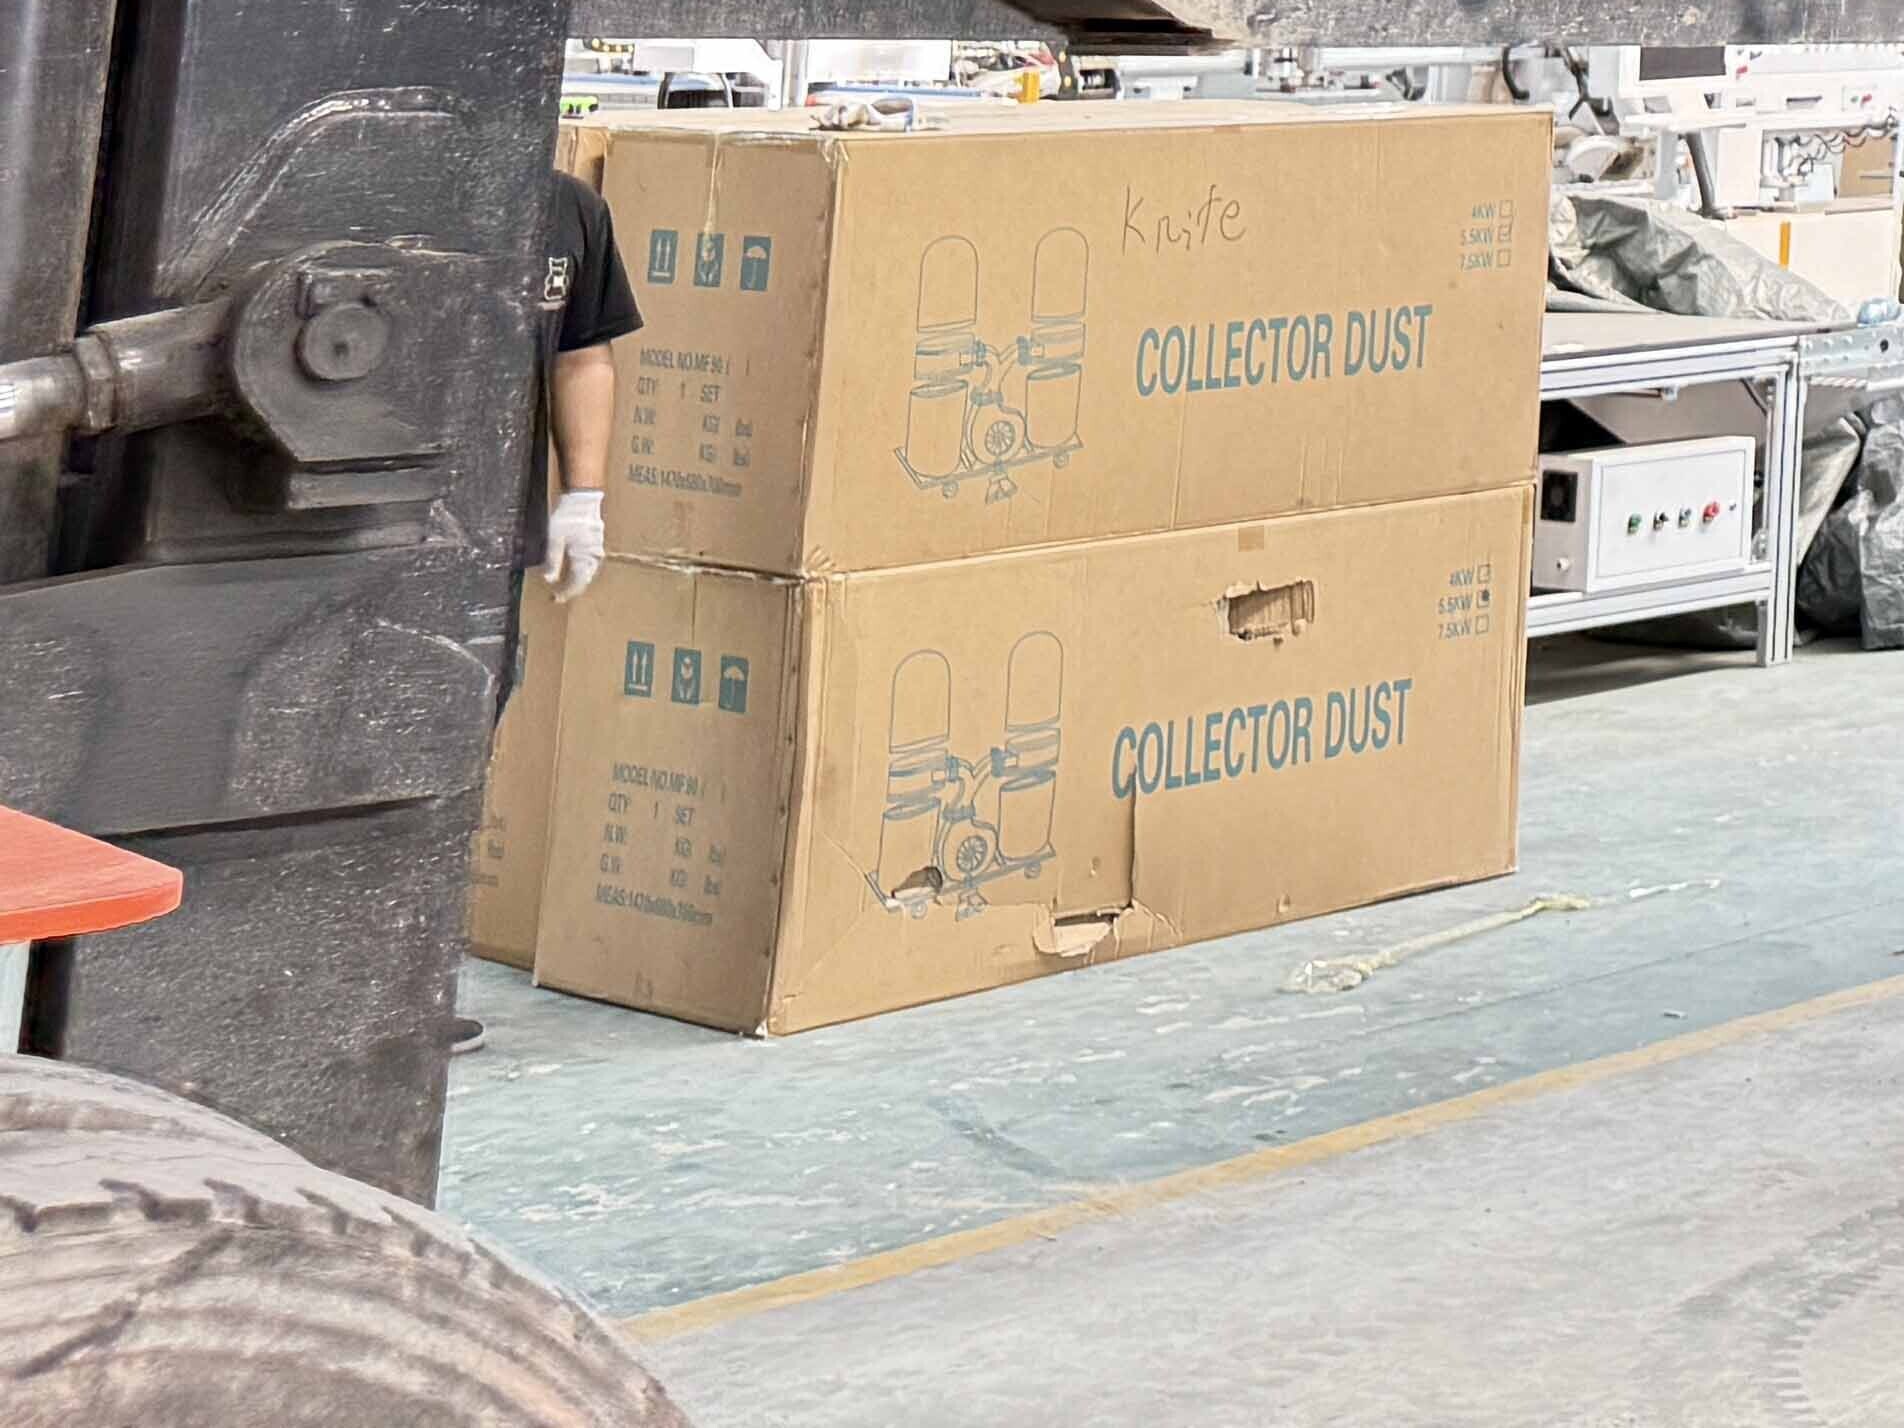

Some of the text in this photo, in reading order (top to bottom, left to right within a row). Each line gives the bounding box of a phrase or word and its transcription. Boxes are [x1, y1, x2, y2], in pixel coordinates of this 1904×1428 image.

[1136, 304, 1433, 397] COLLECTOR DUST
[1112, 678, 1413, 799] COLLECTOR DUST
